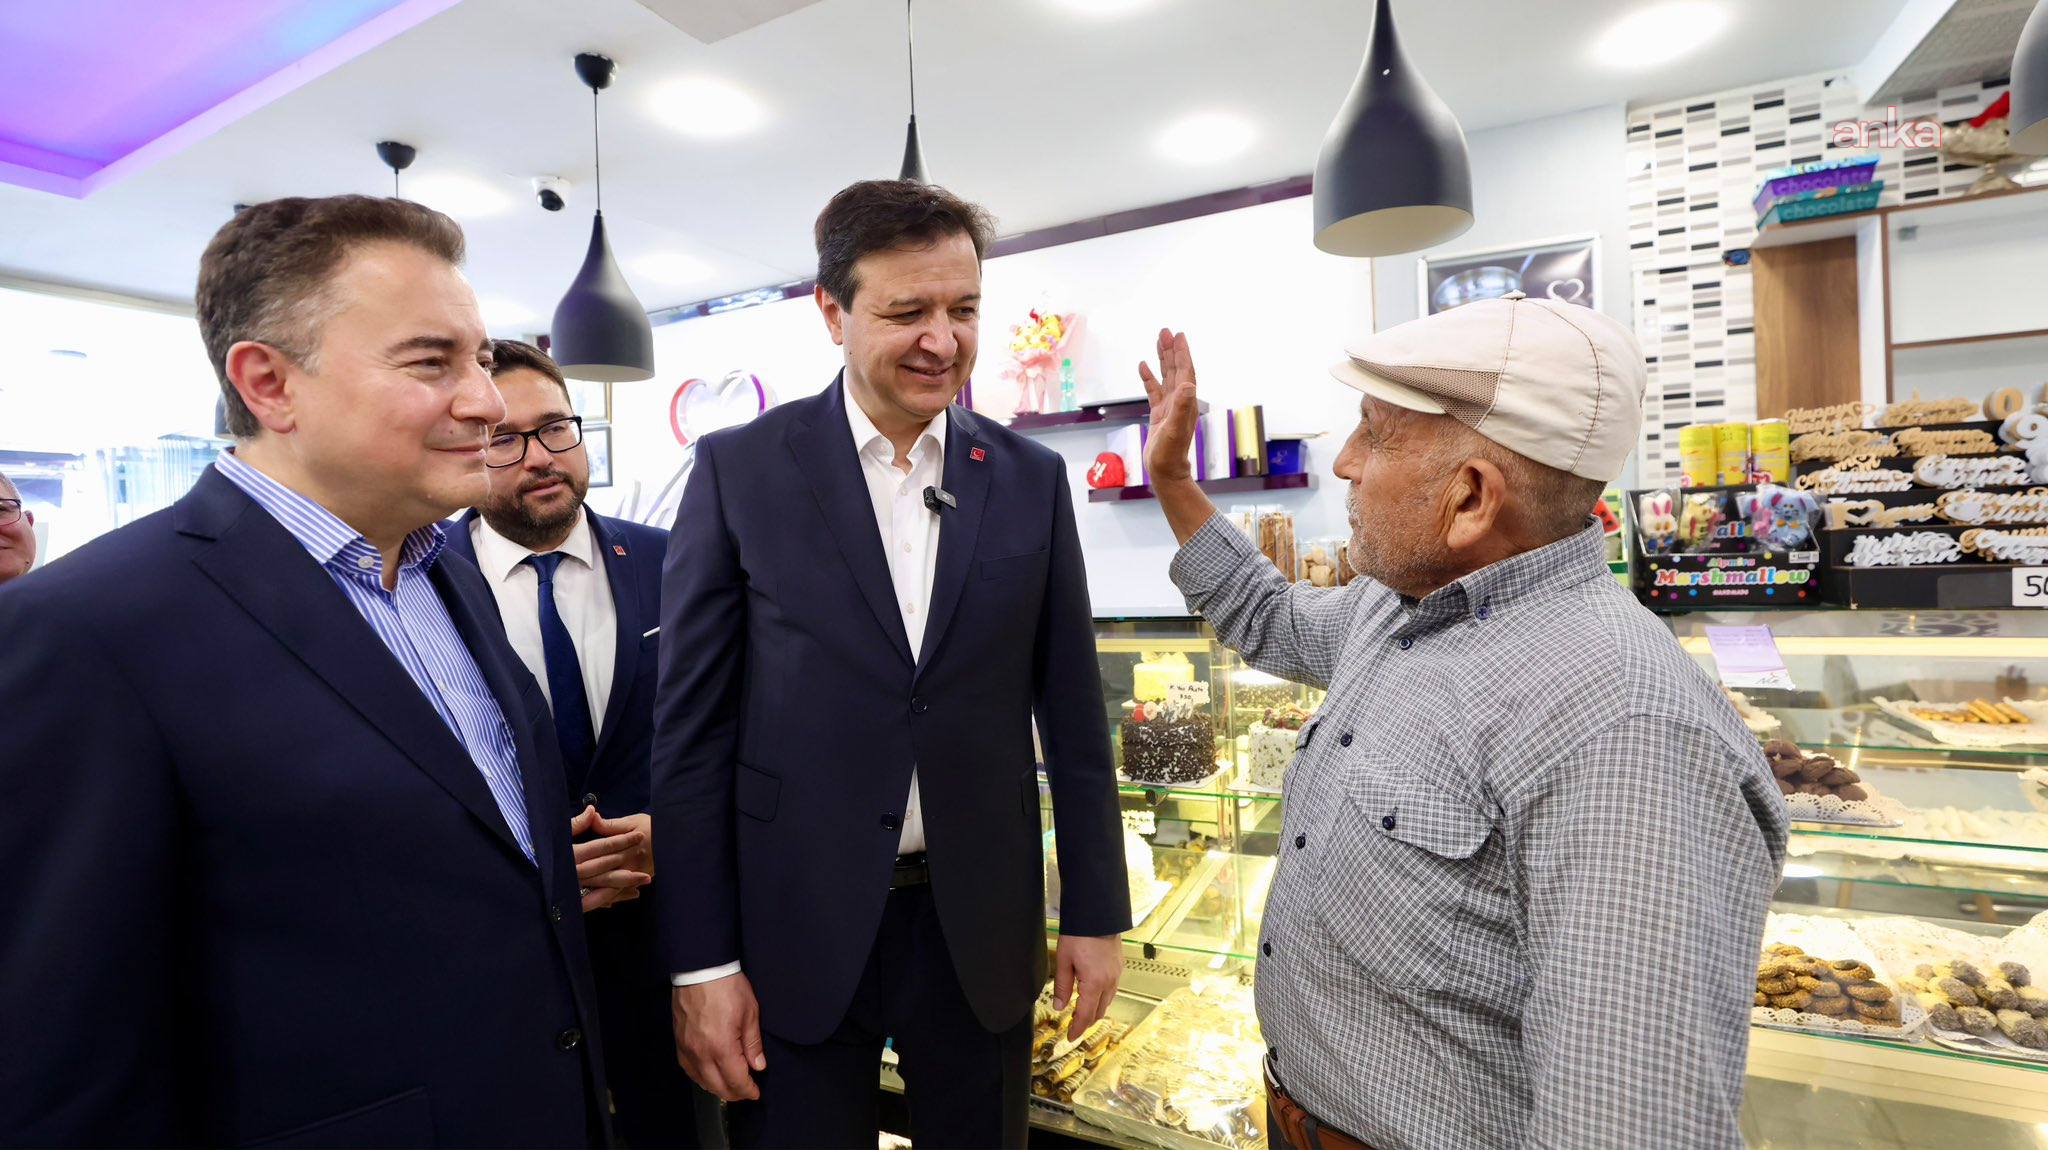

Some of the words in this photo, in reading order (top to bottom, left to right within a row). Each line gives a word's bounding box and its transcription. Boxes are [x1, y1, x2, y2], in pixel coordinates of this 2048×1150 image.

[1777, 170, 1871, 195] chocolate
[1784, 196, 1876, 220] chocolate
[1655, 567, 1811, 587] Marshmallow
